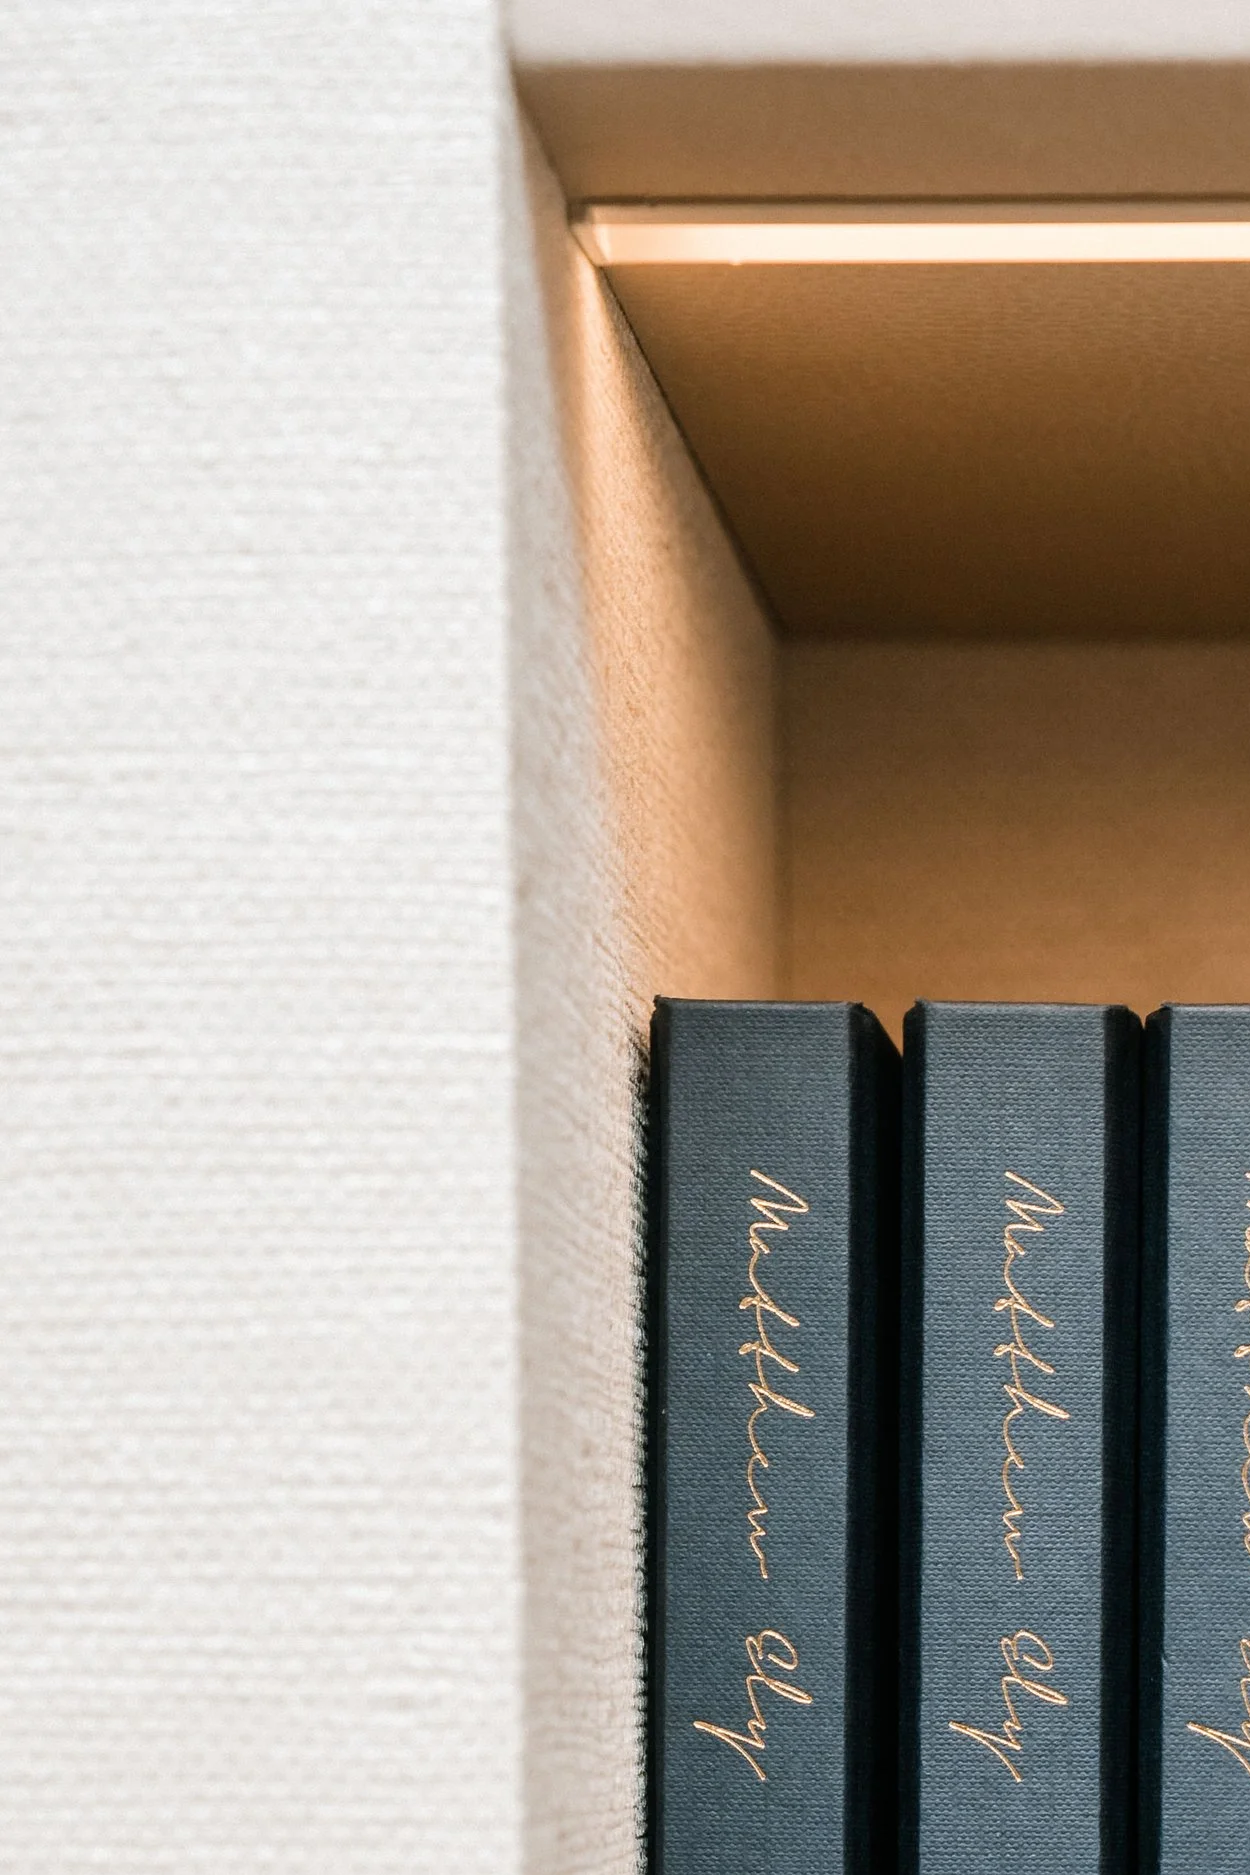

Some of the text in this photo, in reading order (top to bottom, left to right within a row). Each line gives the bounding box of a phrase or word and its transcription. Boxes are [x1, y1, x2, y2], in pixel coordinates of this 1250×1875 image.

[694, 1170, 815, 1779] Matthew Ely
[951, 1172, 1068, 1781] Matthew Ely
